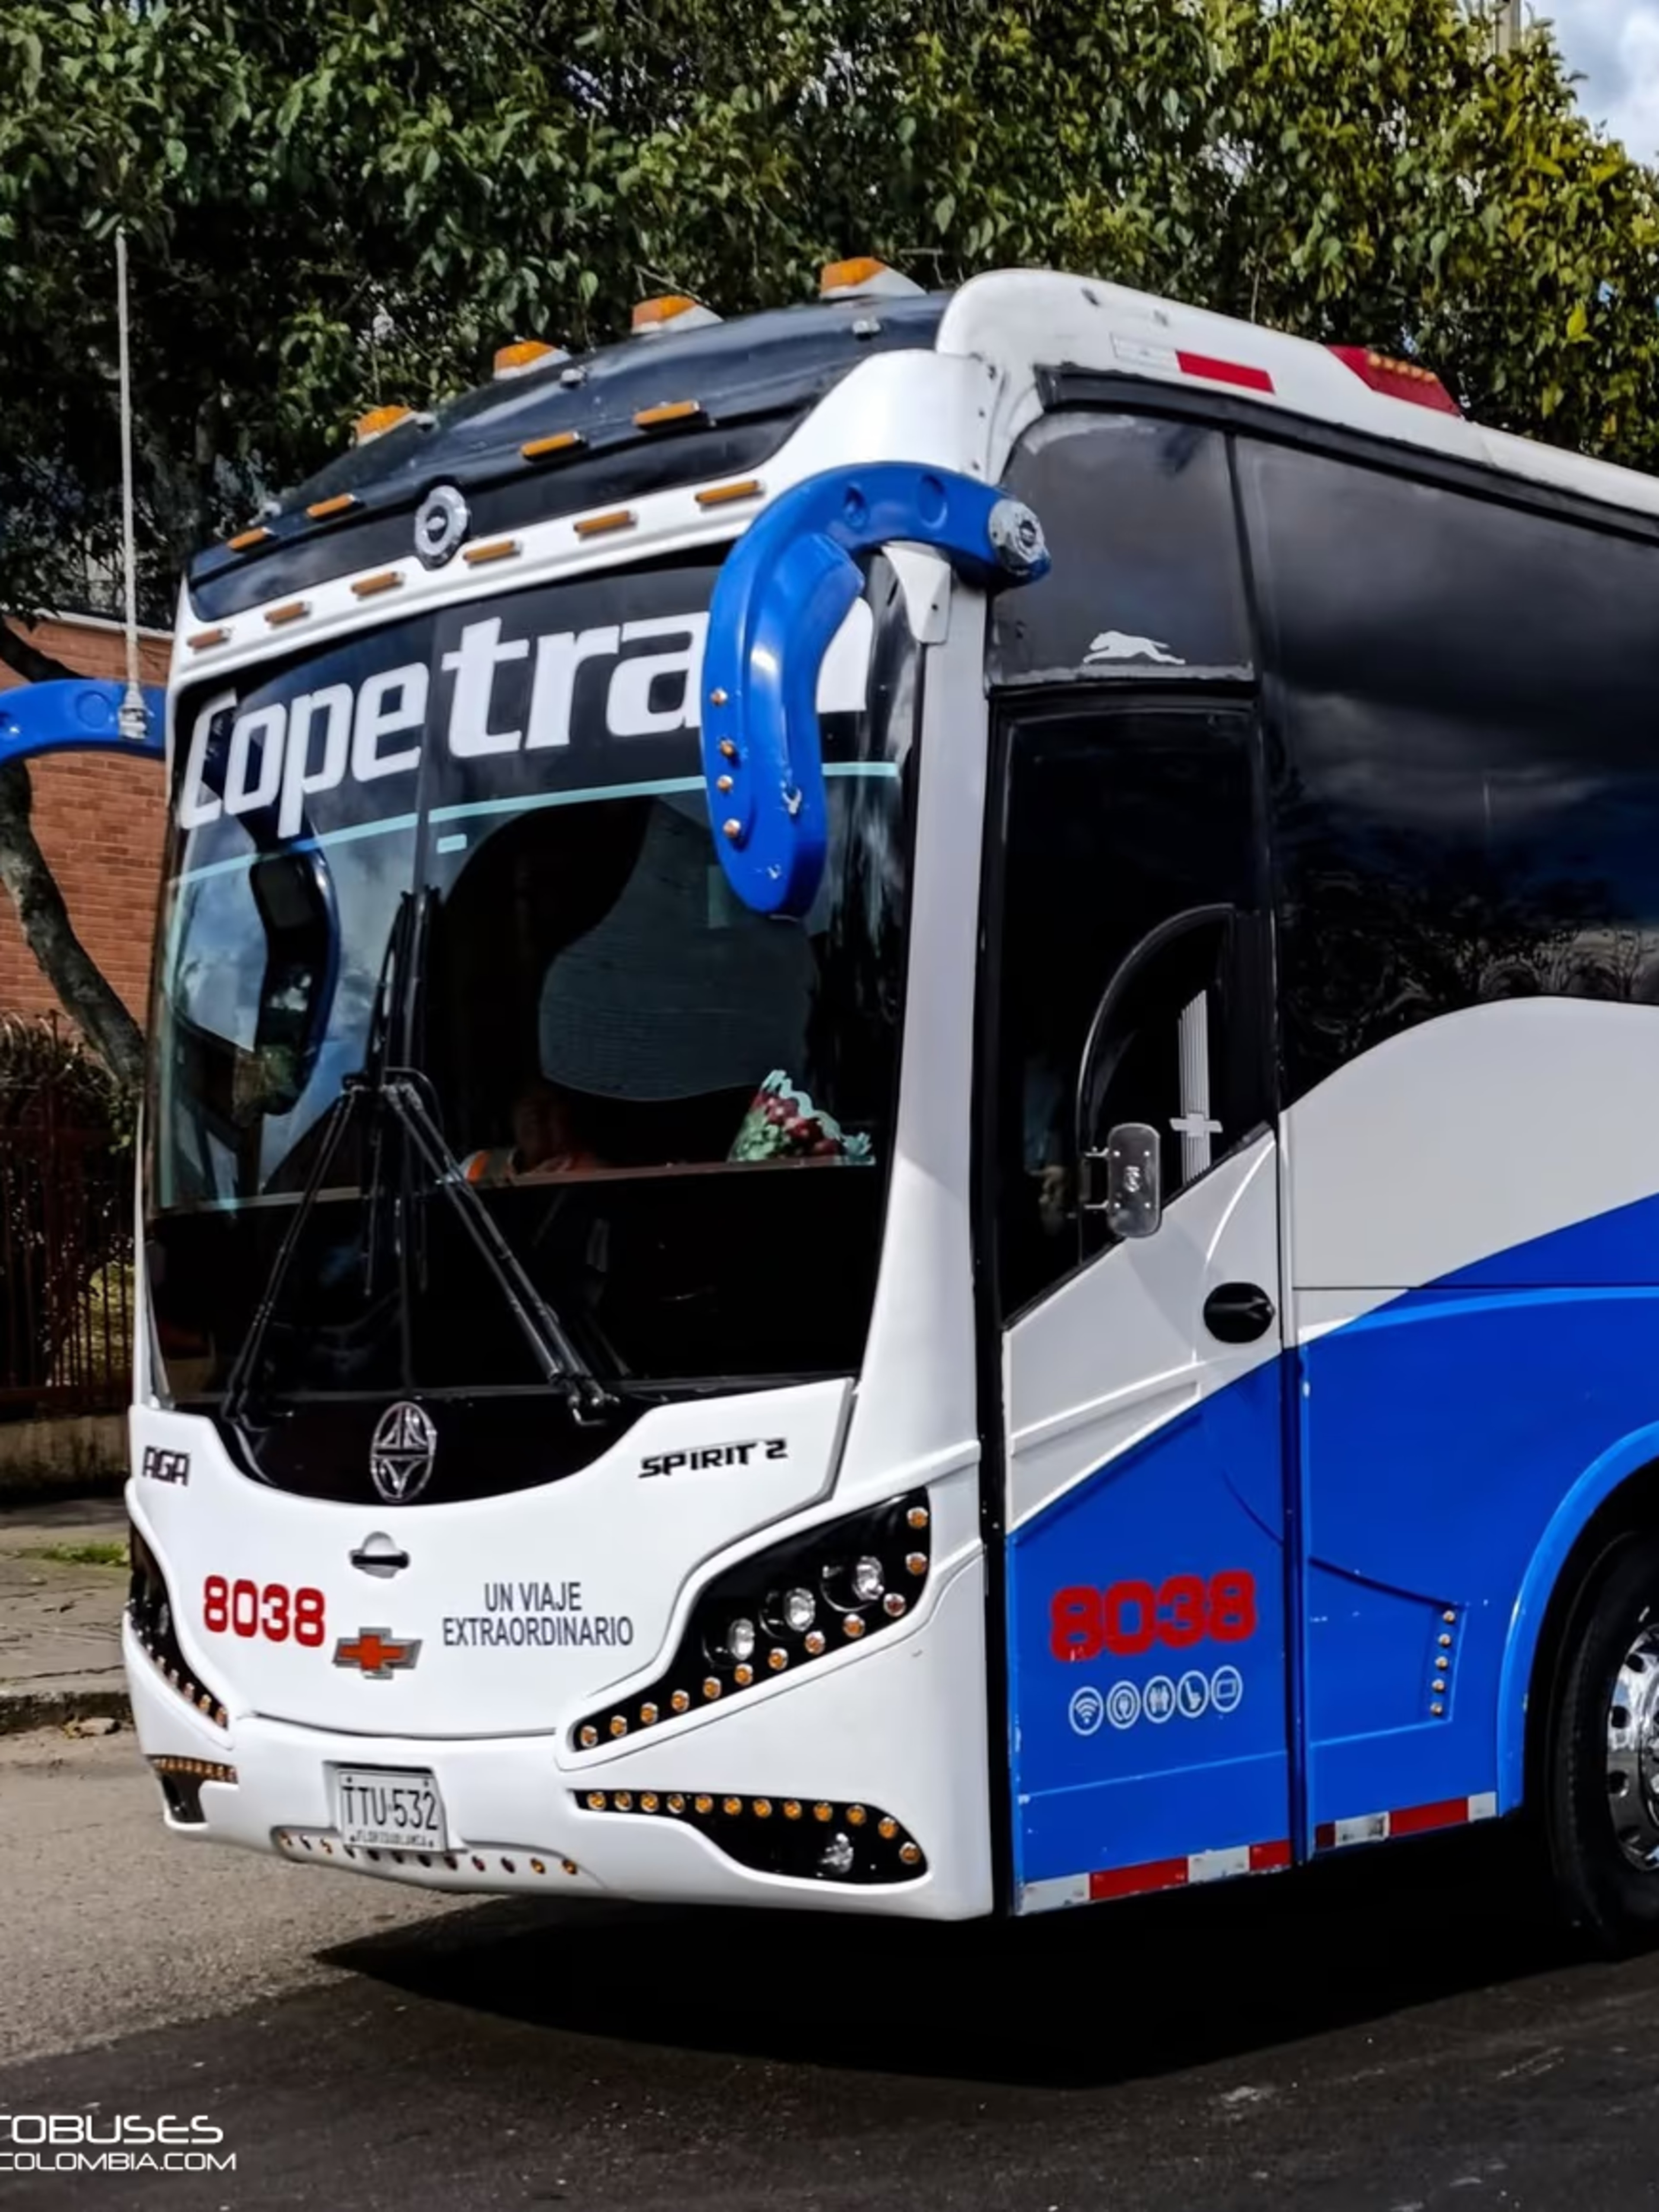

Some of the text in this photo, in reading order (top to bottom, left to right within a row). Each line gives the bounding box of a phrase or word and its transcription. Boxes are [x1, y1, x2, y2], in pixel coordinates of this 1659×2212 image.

[638, 1438, 788, 1478] SPIRIT 2
[204, 1575, 325, 1647] 8038
[484, 1581, 582, 1611] UN VIAJE
[1050, 1569, 1256, 1662] 8038
[443, 1616, 632, 1646] EXTRAORDINARIO
